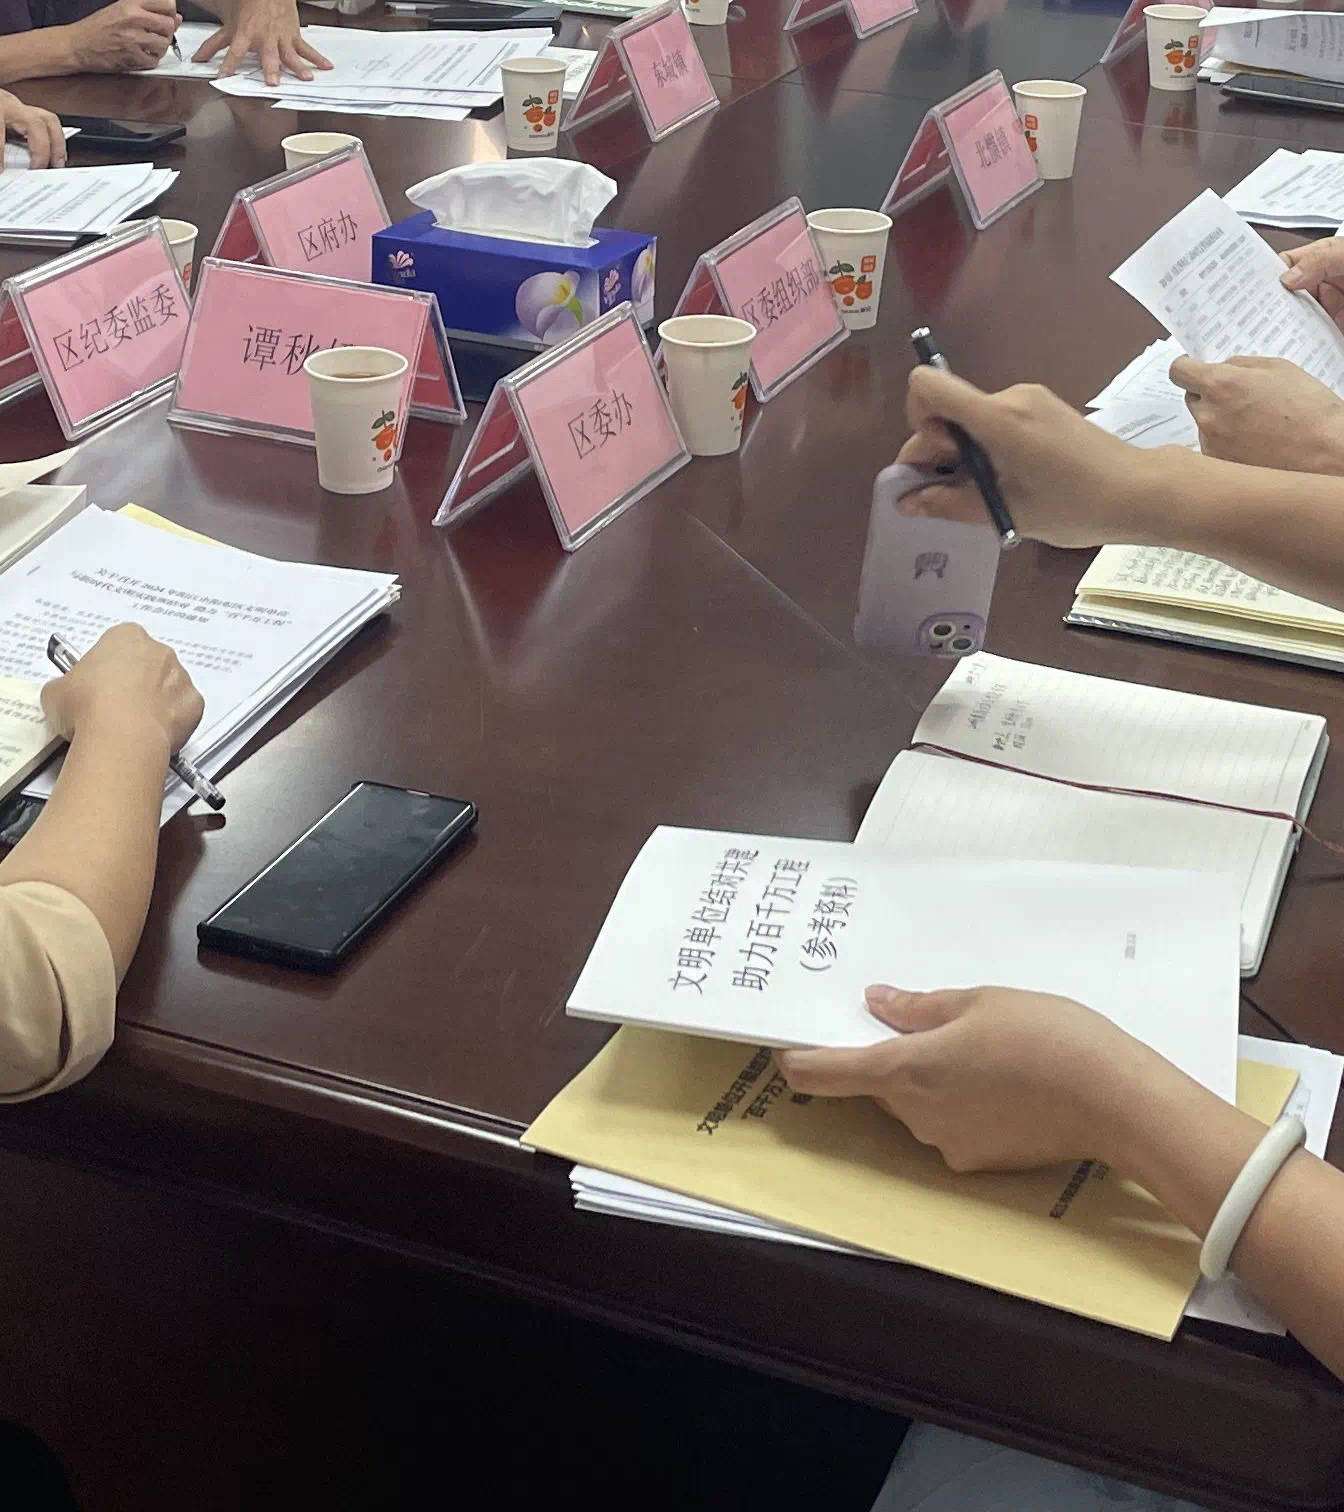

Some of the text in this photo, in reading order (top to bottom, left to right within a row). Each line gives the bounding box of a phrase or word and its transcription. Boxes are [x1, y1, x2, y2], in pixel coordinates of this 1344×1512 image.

[653, 48, 688, 88] 东城镇
[297, 209, 358, 262] 区府办
[53, 282, 179, 372] 区纪委监委
[741, 259, 819, 331] 区委组织部
[242, 324, 356, 376] 谭秋
[569, 388, 633, 460] 区委办
[667, 848, 759, 995] 文明单位结对共建
[731, 859, 810, 991] 助力百千万工程
[800, 877, 858, 972] （参考资料）
